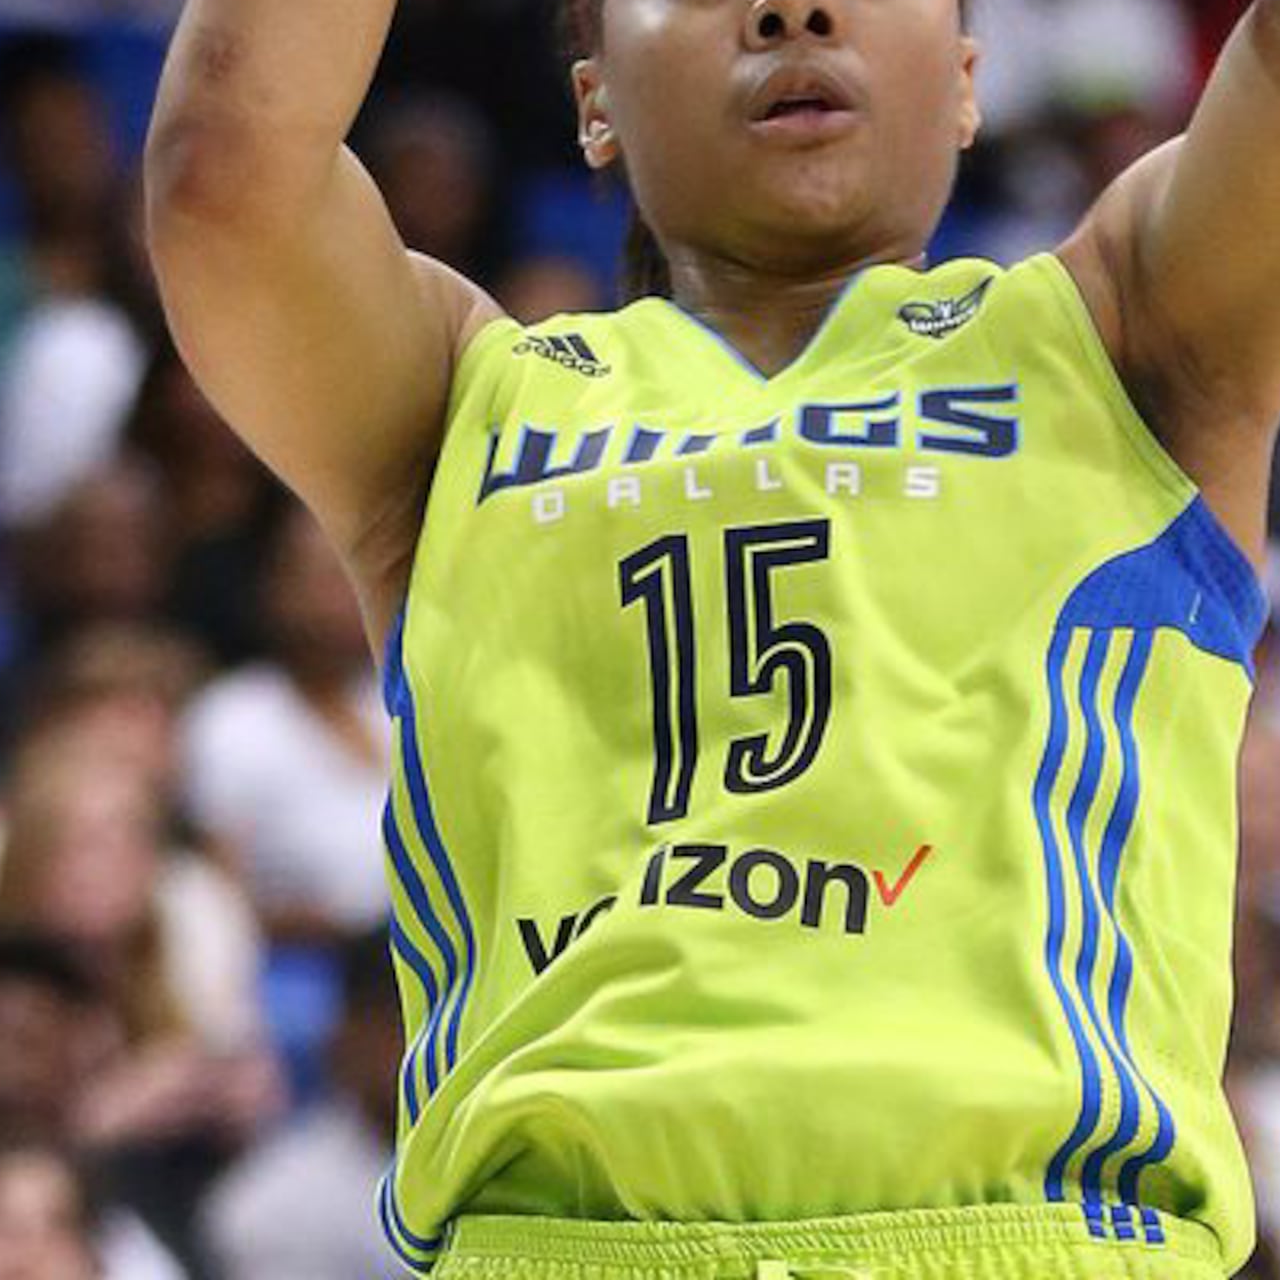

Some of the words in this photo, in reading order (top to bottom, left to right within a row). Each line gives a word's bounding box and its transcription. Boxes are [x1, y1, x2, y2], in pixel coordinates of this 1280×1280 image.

[530, 458, 940, 525] DALLAS
[618, 518, 832, 825] 15
[515, 843, 871, 978] vizon
